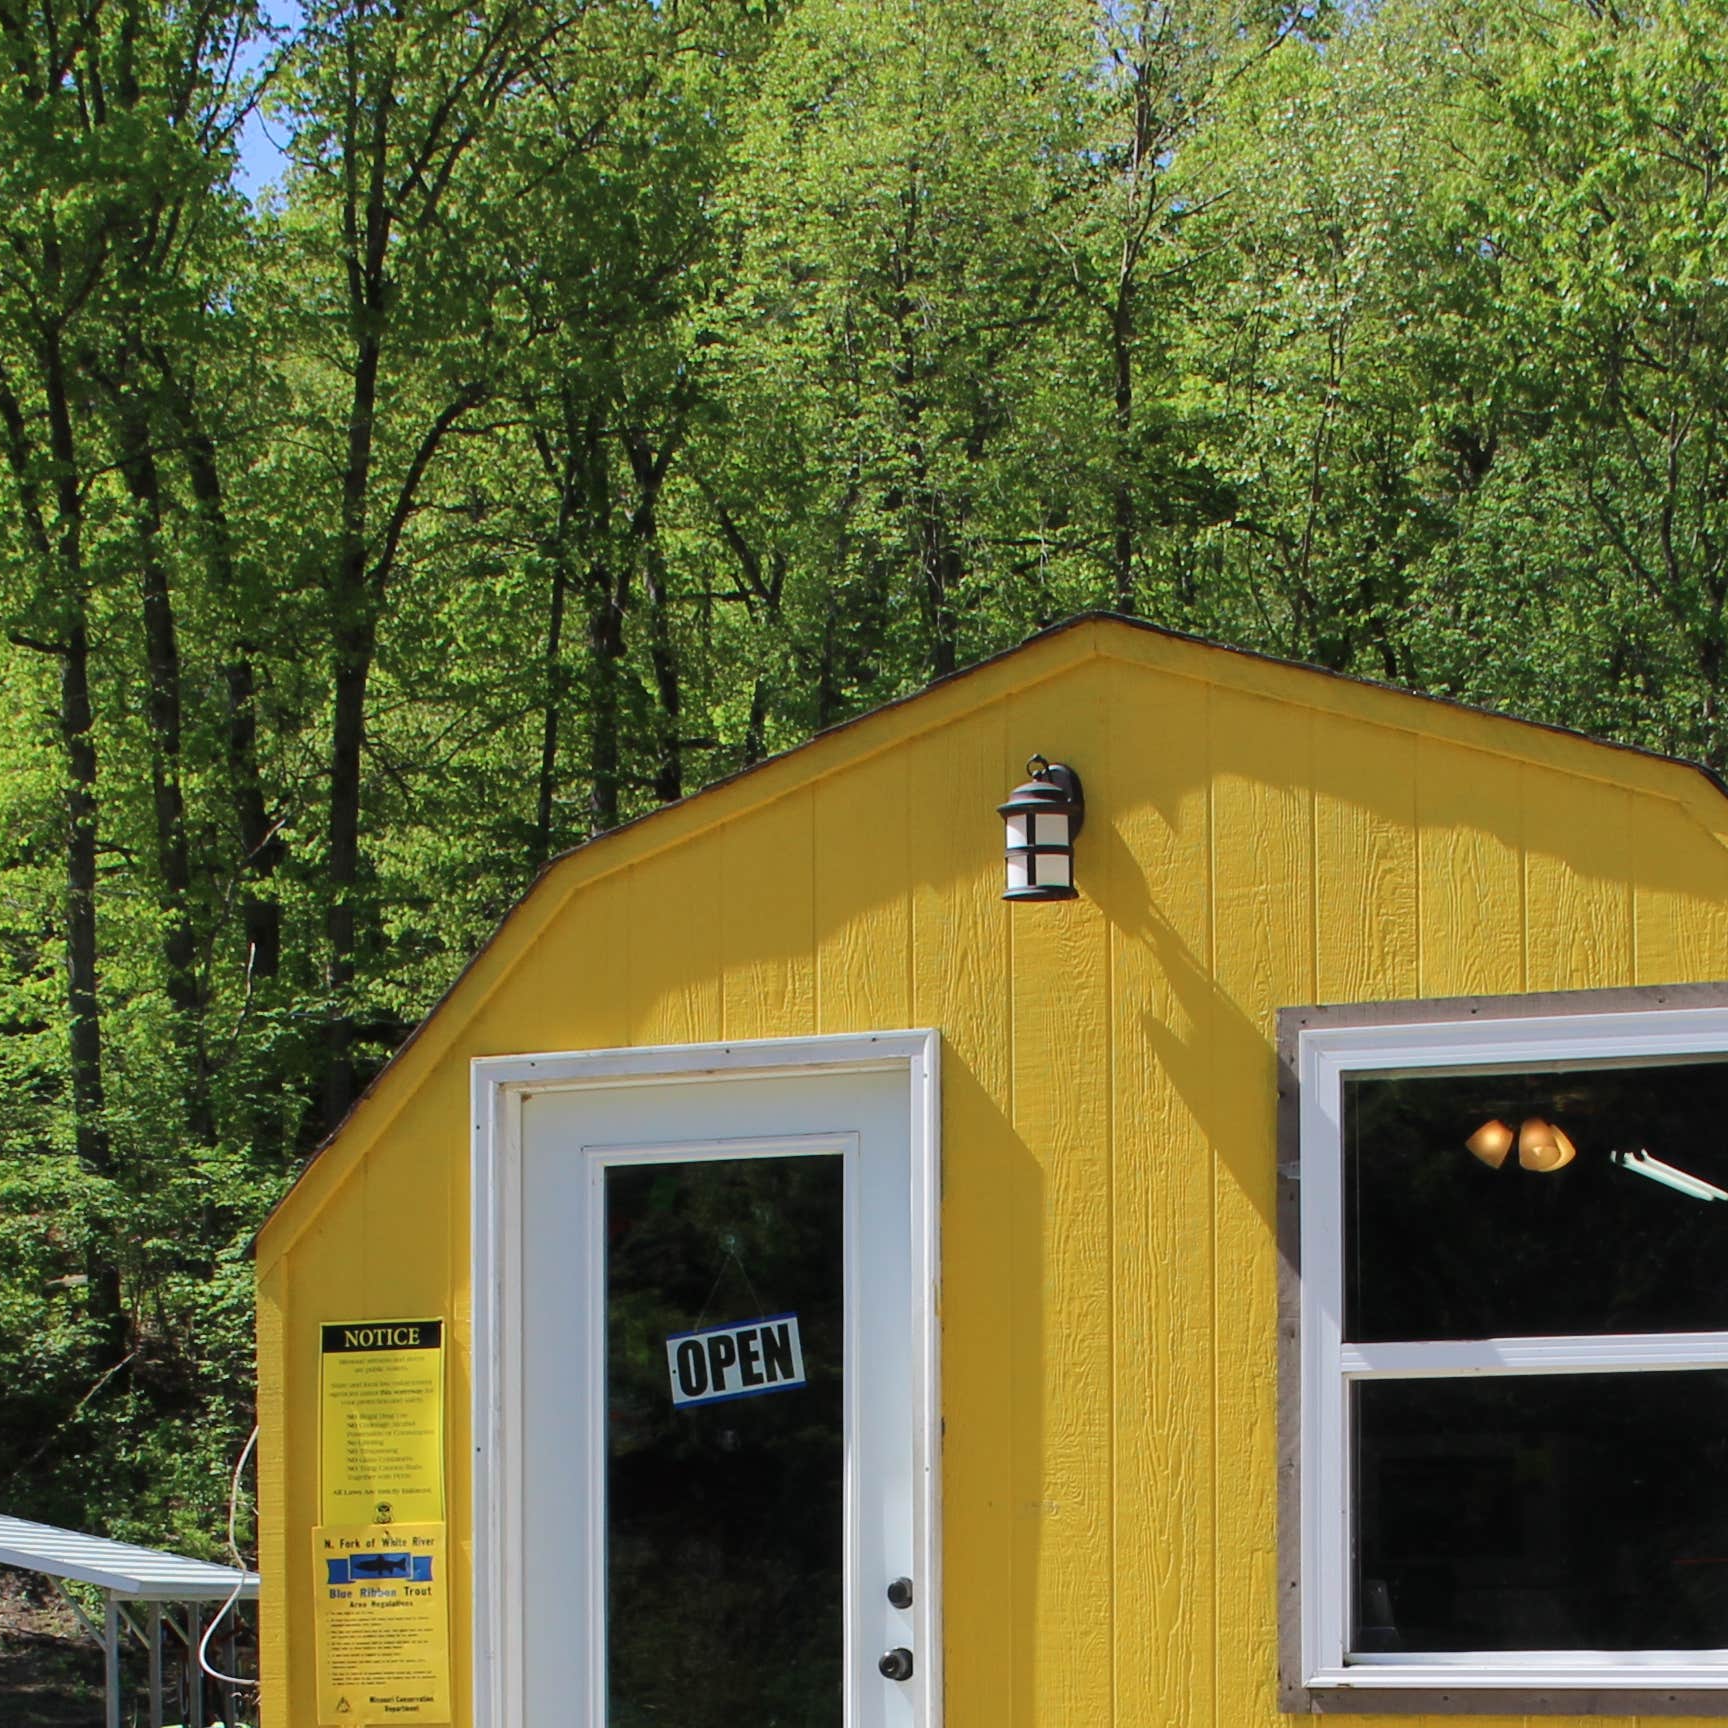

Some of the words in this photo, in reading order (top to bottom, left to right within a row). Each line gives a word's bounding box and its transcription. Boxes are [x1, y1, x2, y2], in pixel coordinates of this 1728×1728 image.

[344, 1328, 421, 1347] NOTICE
[677, 1324, 795, 1397] OPEN
[324, 1539, 334, 1549] N.
[340, 1538, 360, 1549] Fork
[366, 1538, 376, 1548] of
[382, 1537, 407, 1547] White
[412, 1536, 434, 1546] River
[329, 1589, 352, 1599] Blue
[360, 1588, 396, 1598] Ribbon
[403, 1586, 432, 1596] Trout
[371, 1600, 414, 1609] Regulations
